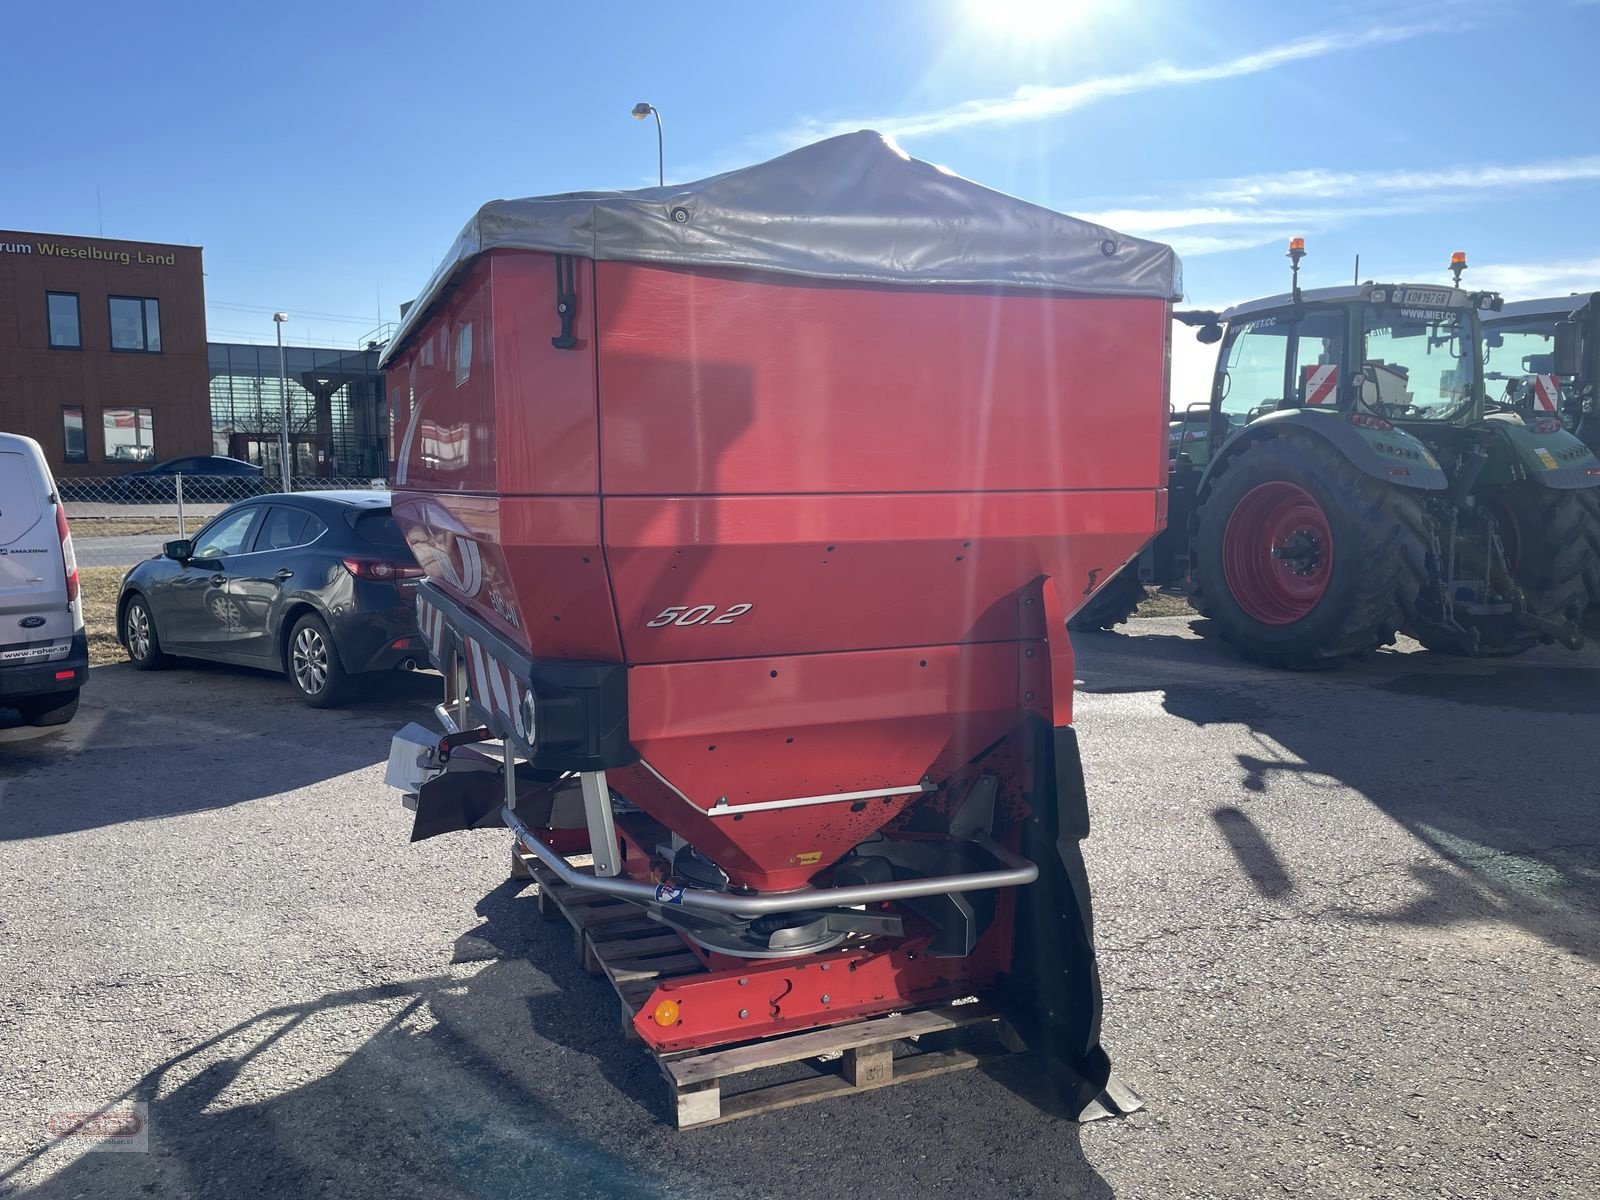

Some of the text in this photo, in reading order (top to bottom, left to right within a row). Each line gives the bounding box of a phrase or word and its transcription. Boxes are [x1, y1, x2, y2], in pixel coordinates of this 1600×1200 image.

[37, 242, 175, 265] Wieselburg-Land
[1401, 309, 1457, 321] WWW.MIET.CC
[647, 603, 753, 628] 50.2
[4, 645, 69, 658] www.roher.at
